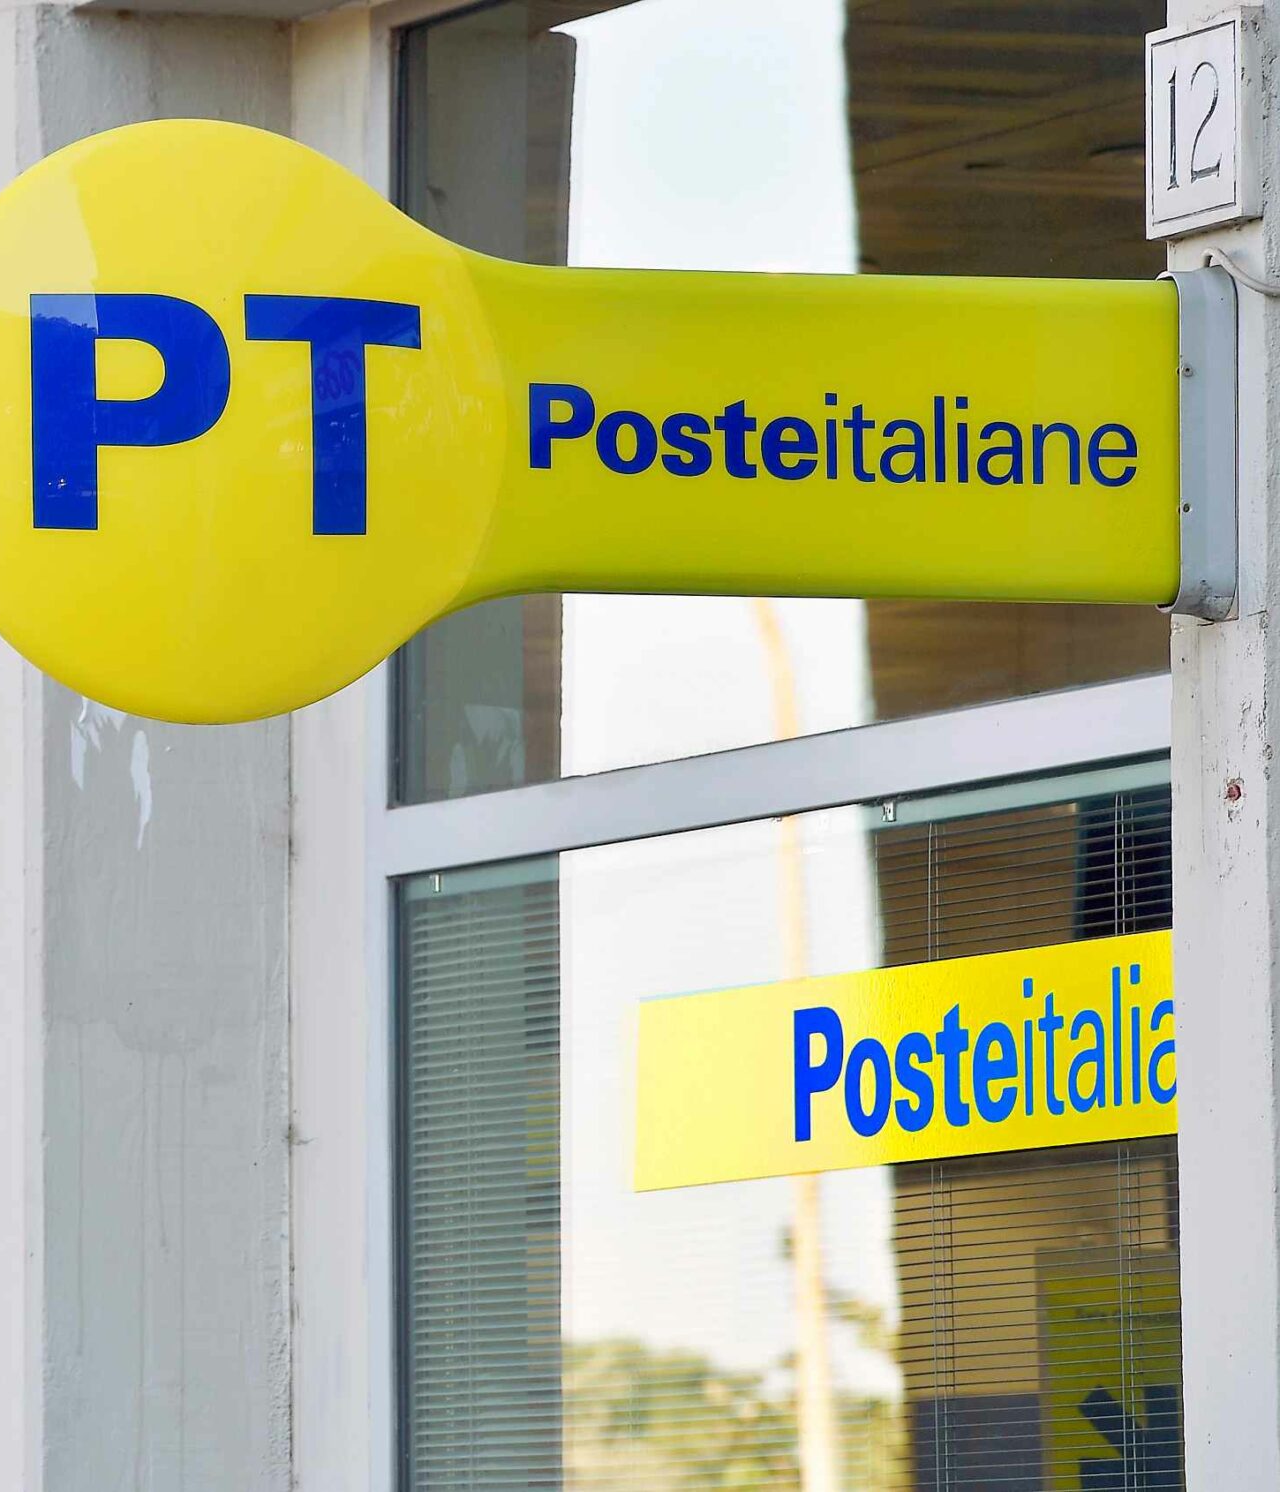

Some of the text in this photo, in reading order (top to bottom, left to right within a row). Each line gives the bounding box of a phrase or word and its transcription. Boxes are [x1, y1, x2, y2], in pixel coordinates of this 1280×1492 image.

[1167, 61, 1223, 191] 12
[30, 293, 422, 536] PT
[528, 382, 1139, 488] Posteitaliane
